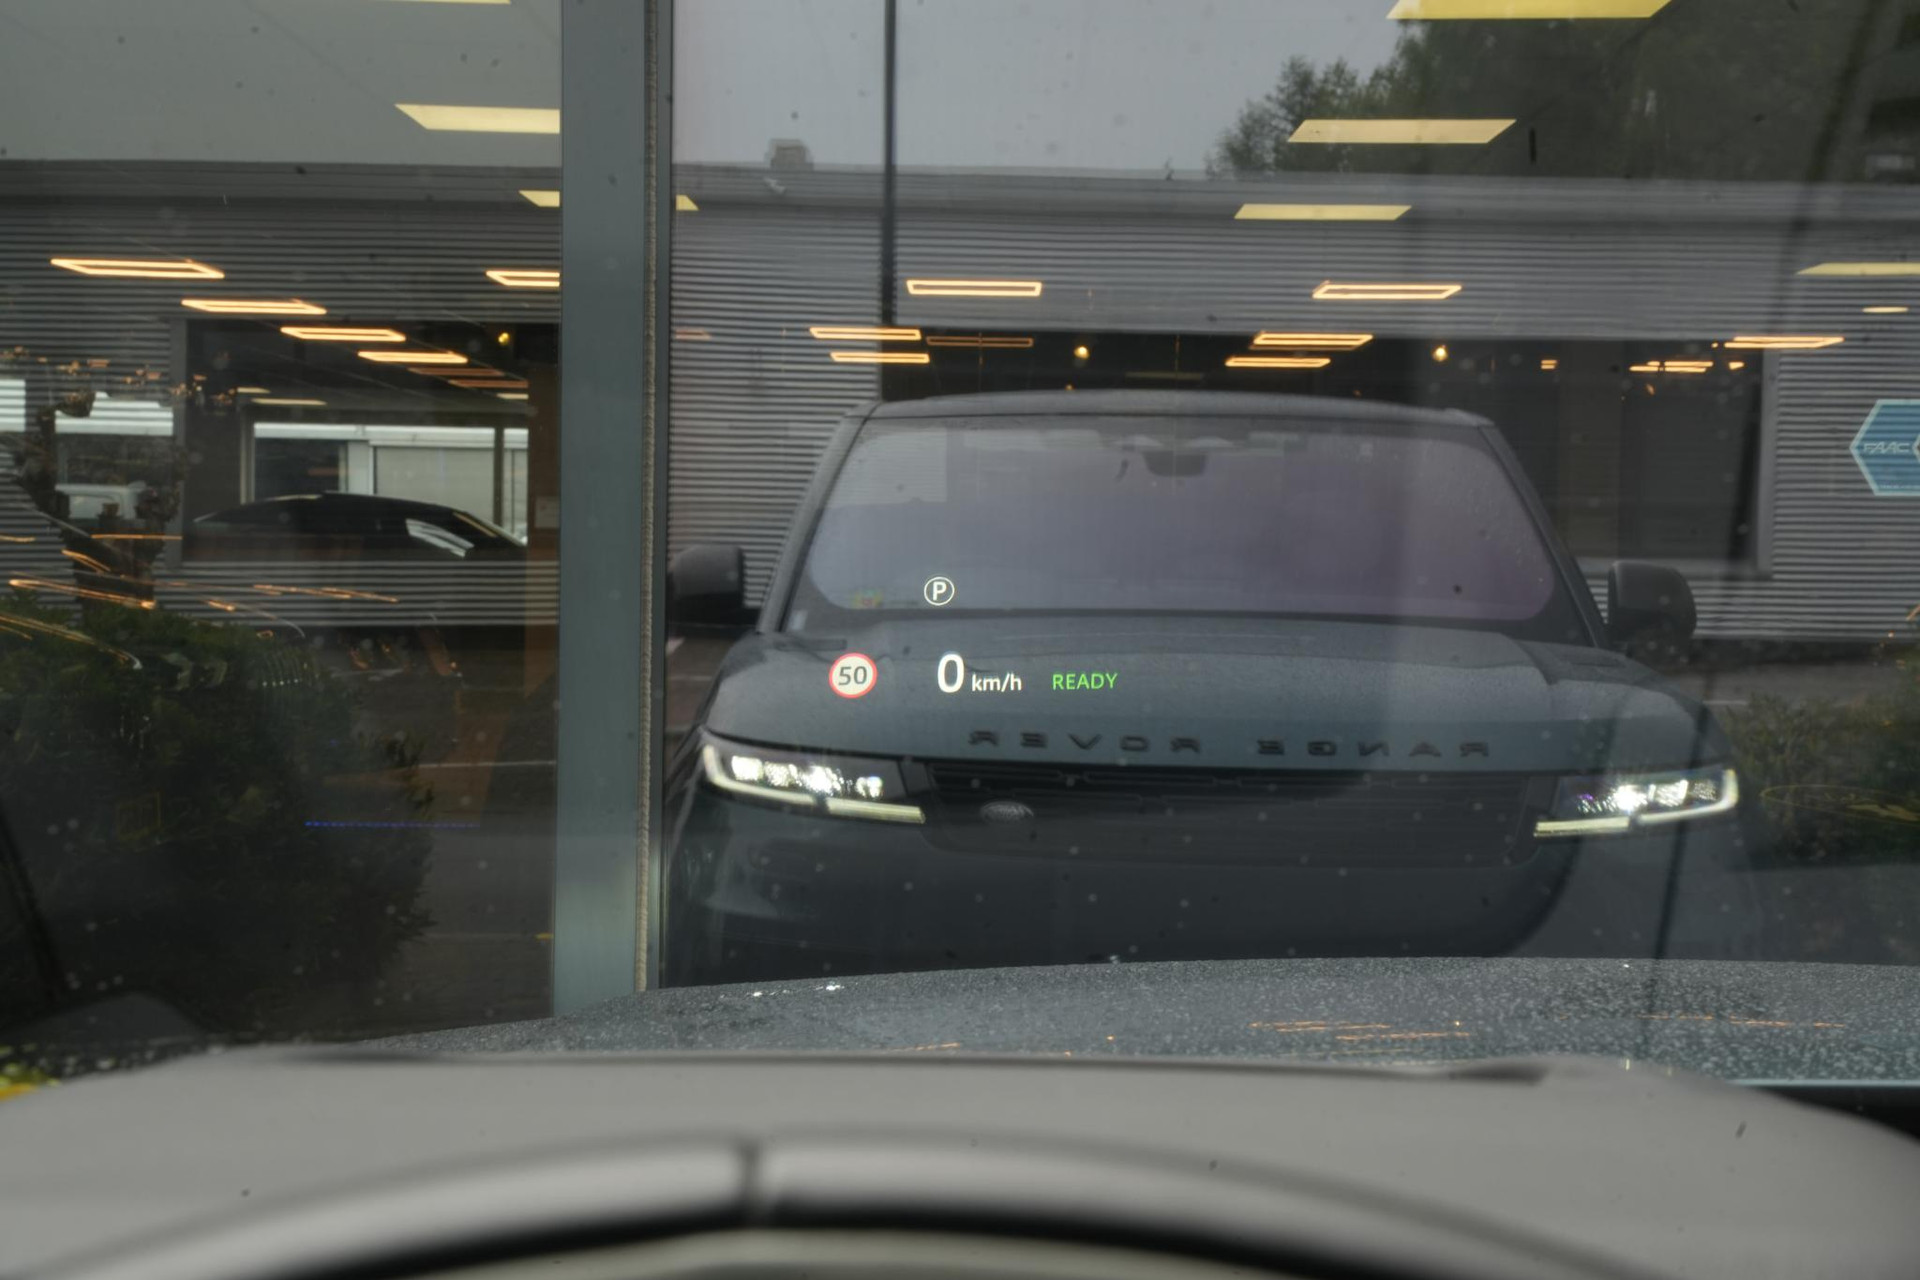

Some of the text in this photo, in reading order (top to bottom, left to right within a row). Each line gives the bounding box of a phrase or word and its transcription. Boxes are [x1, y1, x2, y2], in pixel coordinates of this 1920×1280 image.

[1863, 441, 1910, 454] FAAC
[837, 665, 868, 686] 50
[937, 652, 1022, 693] 0 km/h
[1052, 672, 1118, 691] READY
